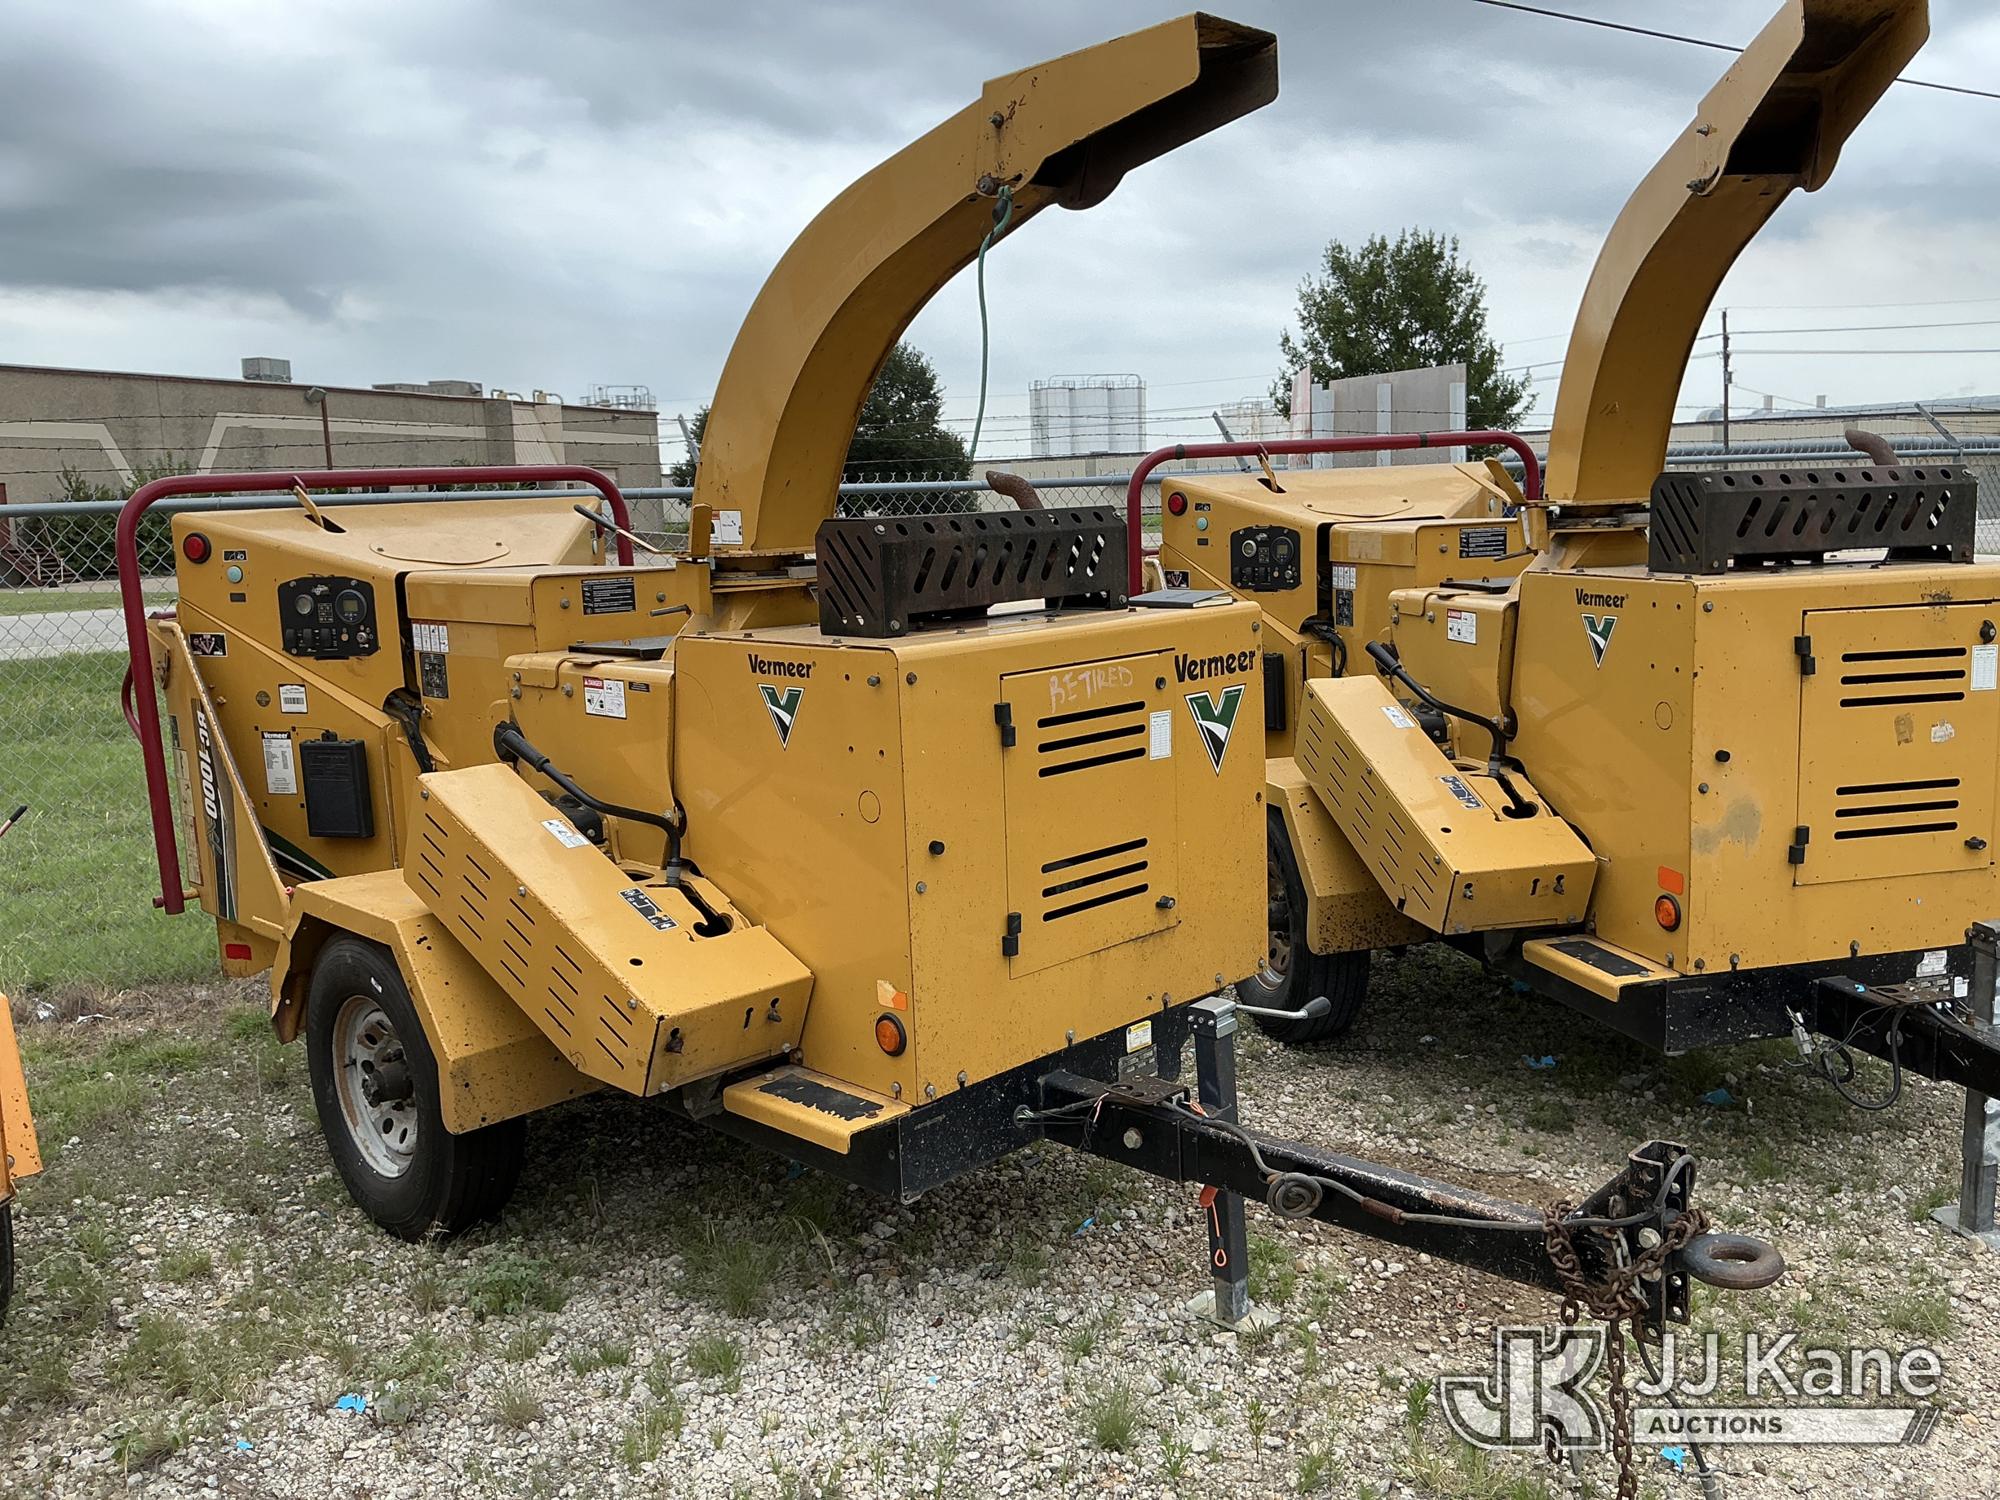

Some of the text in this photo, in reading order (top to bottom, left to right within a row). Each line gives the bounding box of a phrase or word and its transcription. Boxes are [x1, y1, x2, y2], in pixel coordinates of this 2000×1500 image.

[1575, 588, 1625, 608] Vermeer
[747, 653, 812, 679] Vermeer
[1174, 649, 1256, 683] Vermeer
